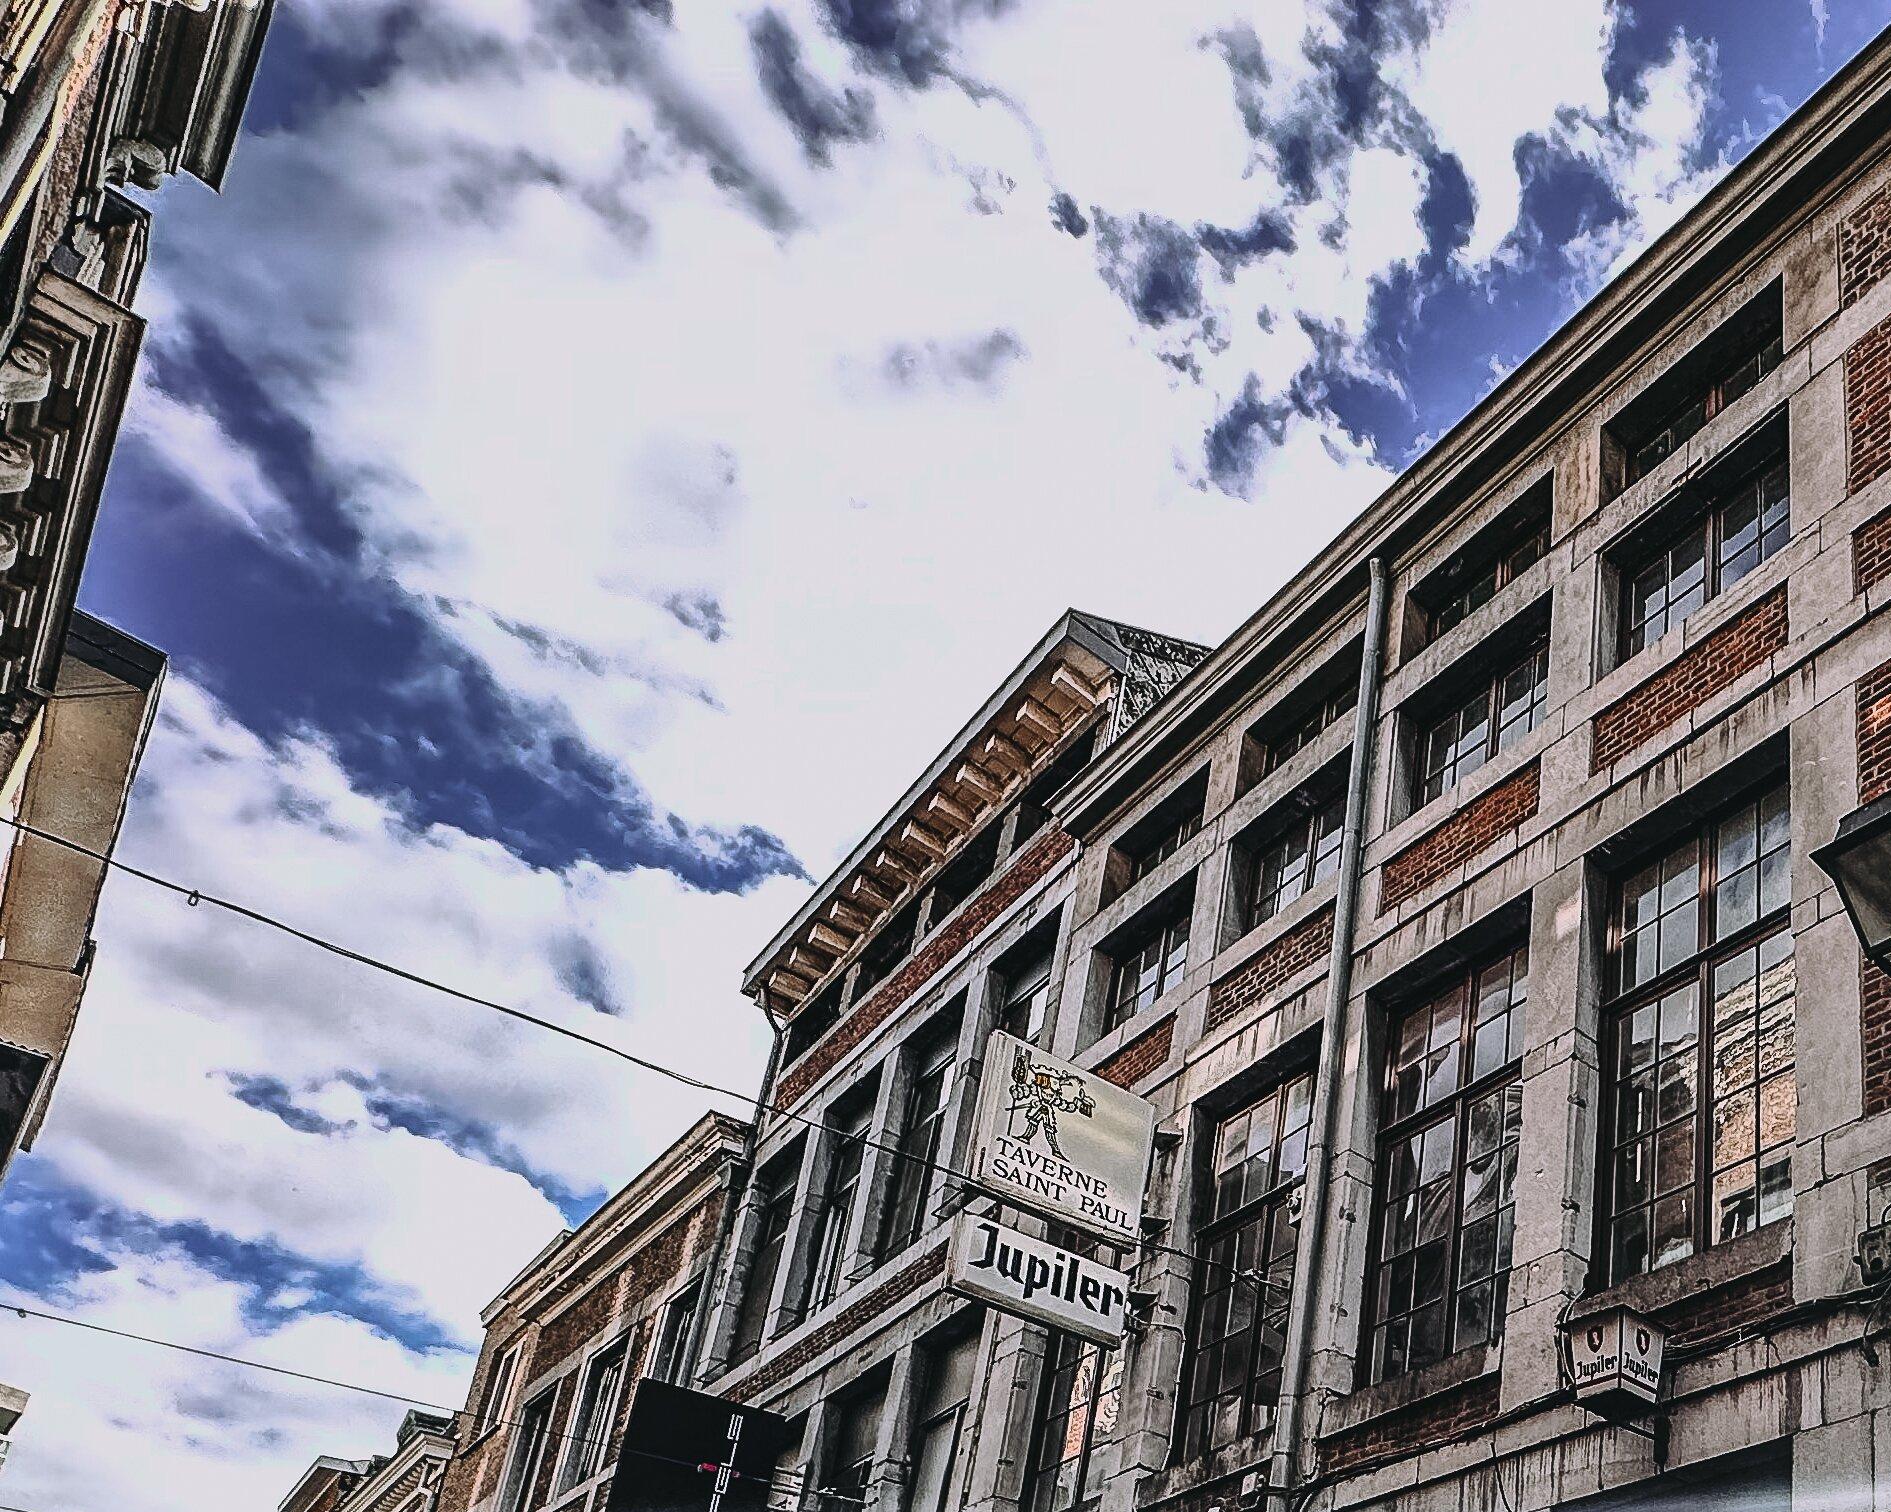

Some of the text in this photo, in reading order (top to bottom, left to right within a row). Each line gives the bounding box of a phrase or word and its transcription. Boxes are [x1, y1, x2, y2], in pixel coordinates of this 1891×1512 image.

[992, 1158, 1135, 1231] SAINT PAUL
[995, 1136, 1108, 1199] TAVERNE
[968, 1223, 1125, 1317] Jupiler
[1576, 1354, 1618, 1381] Jupiler
[1623, 1352, 1659, 1383] Jupiler
